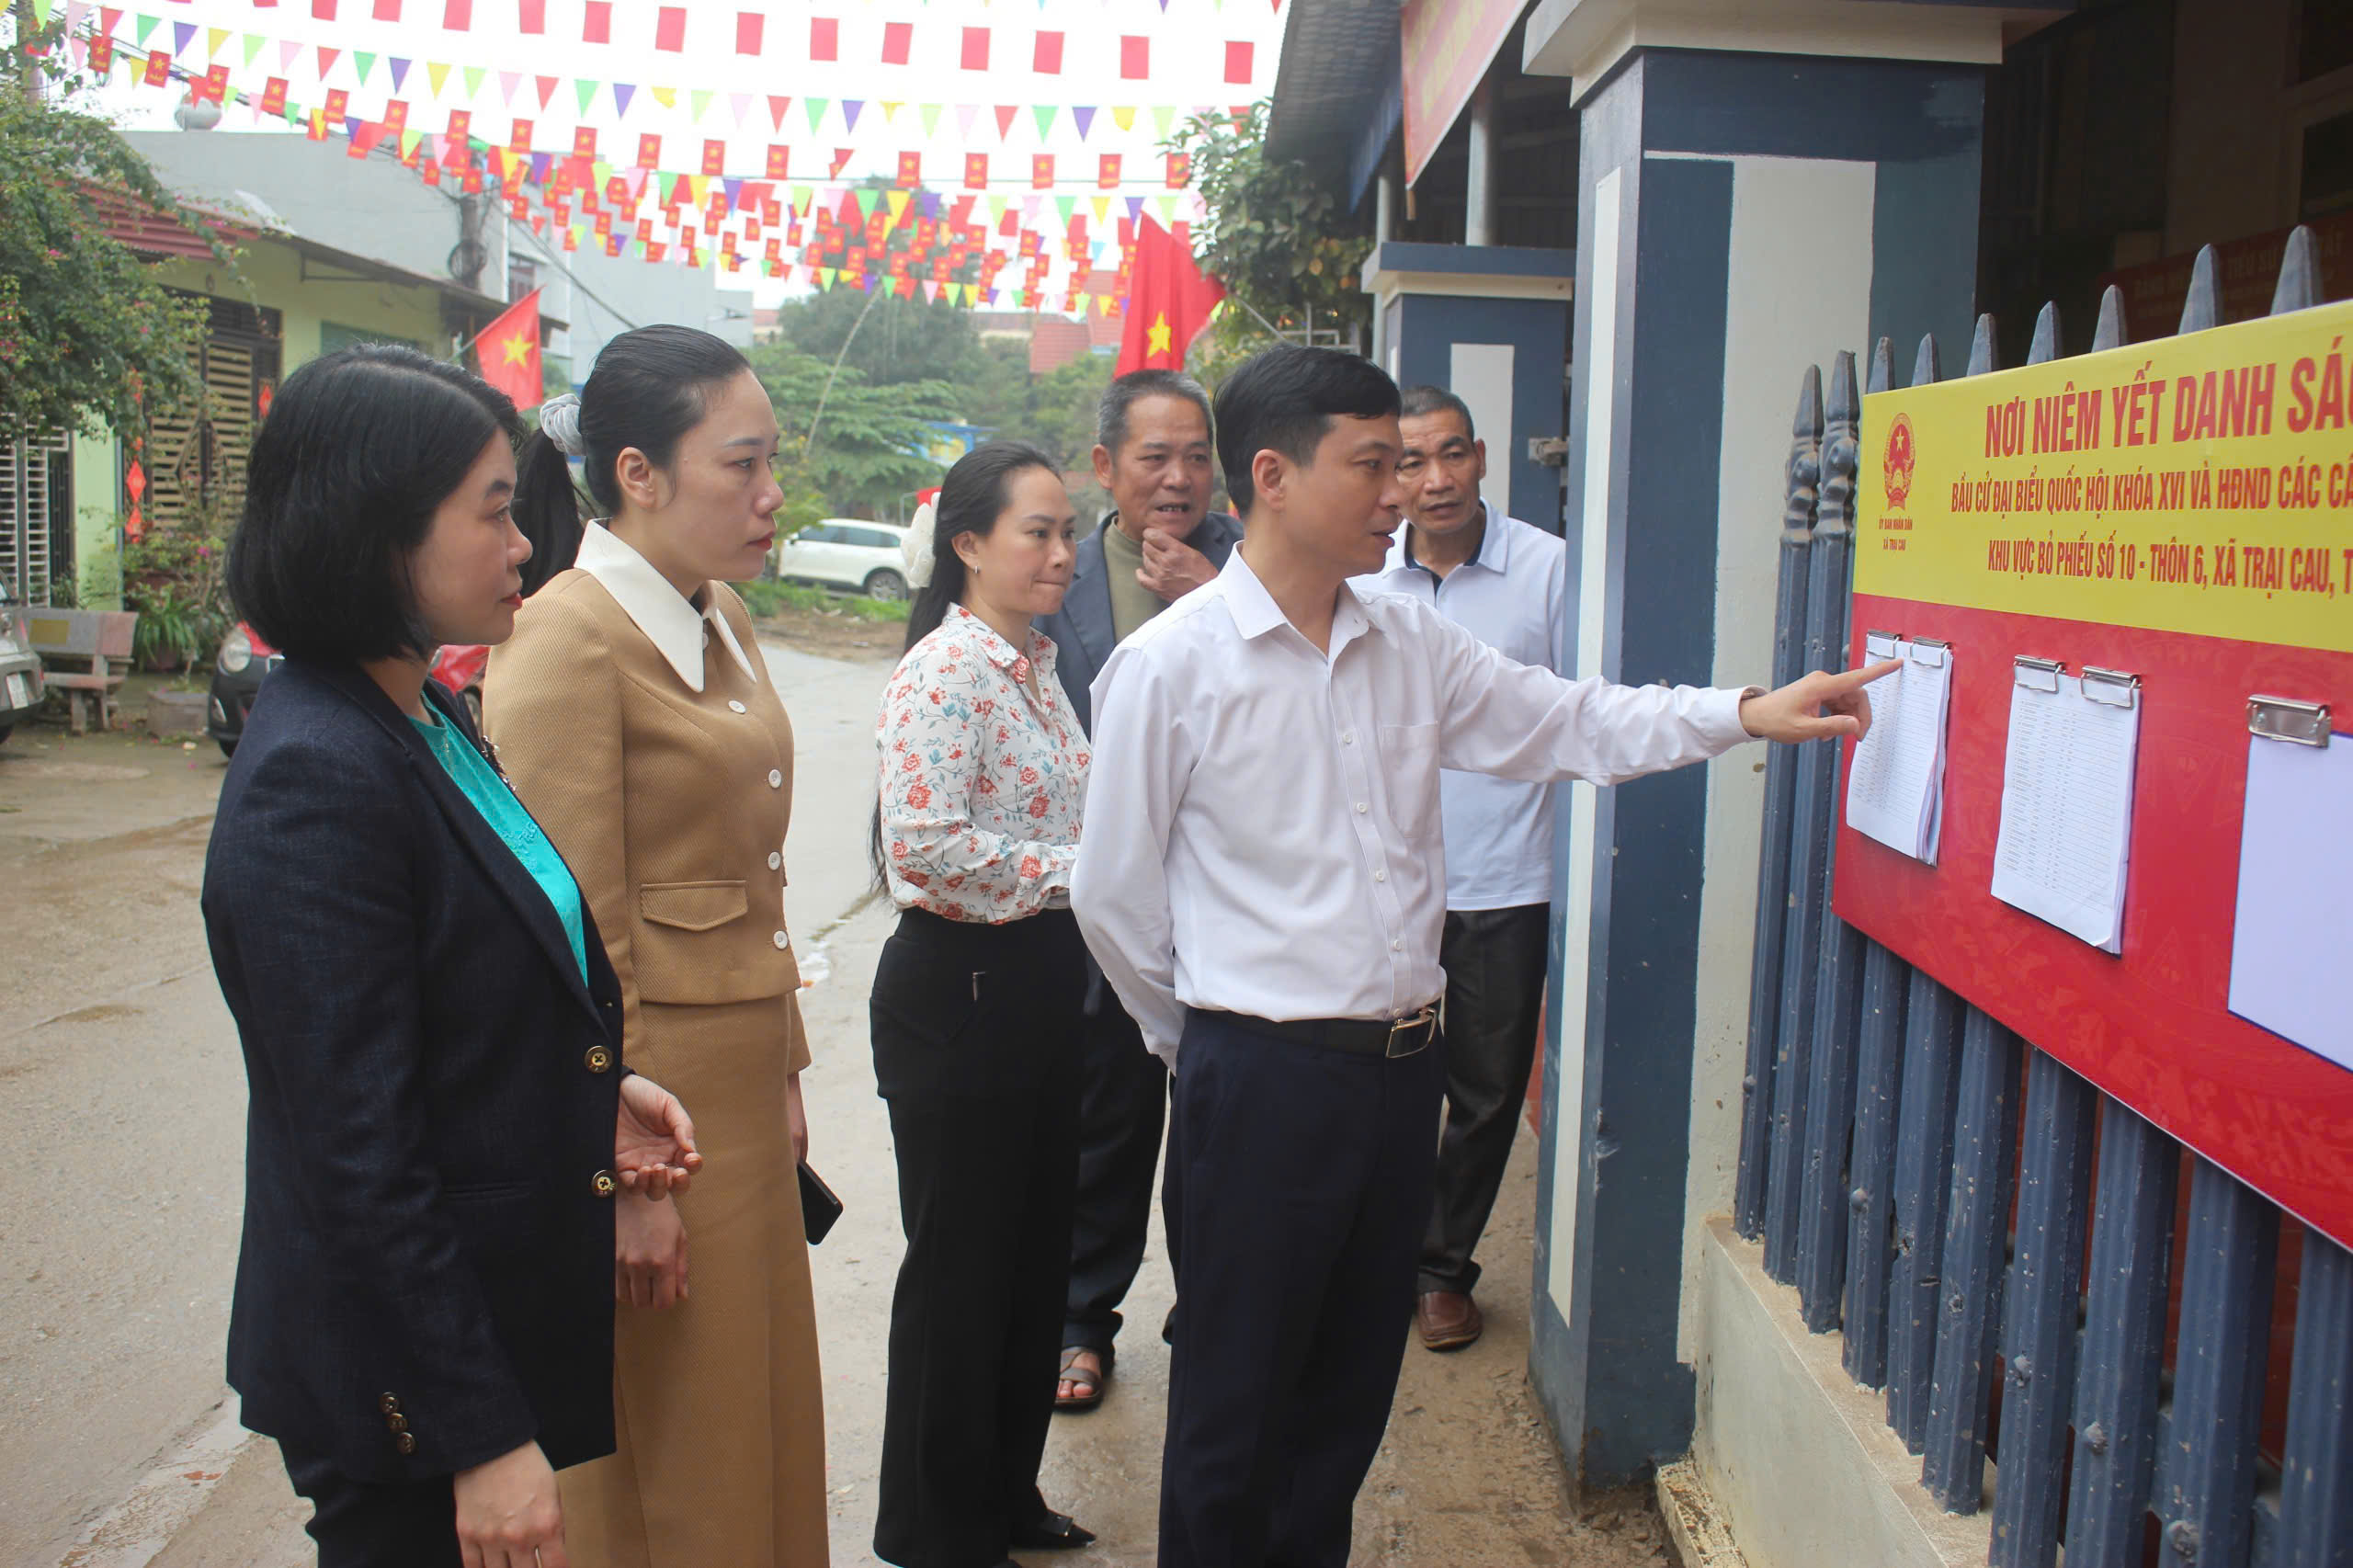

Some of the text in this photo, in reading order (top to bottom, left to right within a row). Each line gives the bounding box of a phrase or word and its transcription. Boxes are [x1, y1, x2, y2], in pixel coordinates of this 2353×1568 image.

[1985, 335, 2353, 458] NƠI NIÊM YẾT DANH SÁ
[1975, 470, 1993, 512] CỬ
[1993, 480, 2013, 519] ĐẠI
[2015, 464, 2044, 512] BIỂU
[2047, 464, 2082, 516] QUỐC
[2085, 468, 2109, 519] HỘI
[2113, 465, 2154, 511] KHÓA
[2158, 472, 2186, 510] XVI
[2191, 460, 2211, 509] VÀ
[2217, 467, 2271, 509] HĐND
[2278, 455, 2322, 509] CÁC
[1988, 540, 2011, 572] KHU
[2013, 538, 2035, 581] VỰC
[2037, 529, 2054, 574] BỎ
[2056, 530, 2094, 577] PHIẾU
[2097, 529, 2117, 579] SỐ
[2120, 544, 2136, 580] 10
[2150, 536, 2190, 583] THÔN
[2193, 545, 2208, 590] 6,
[2212, 538, 2236, 587] XÃ
[2243, 546, 2284, 599] TRẠI
[2290, 547, 2335, 599] CAU,
